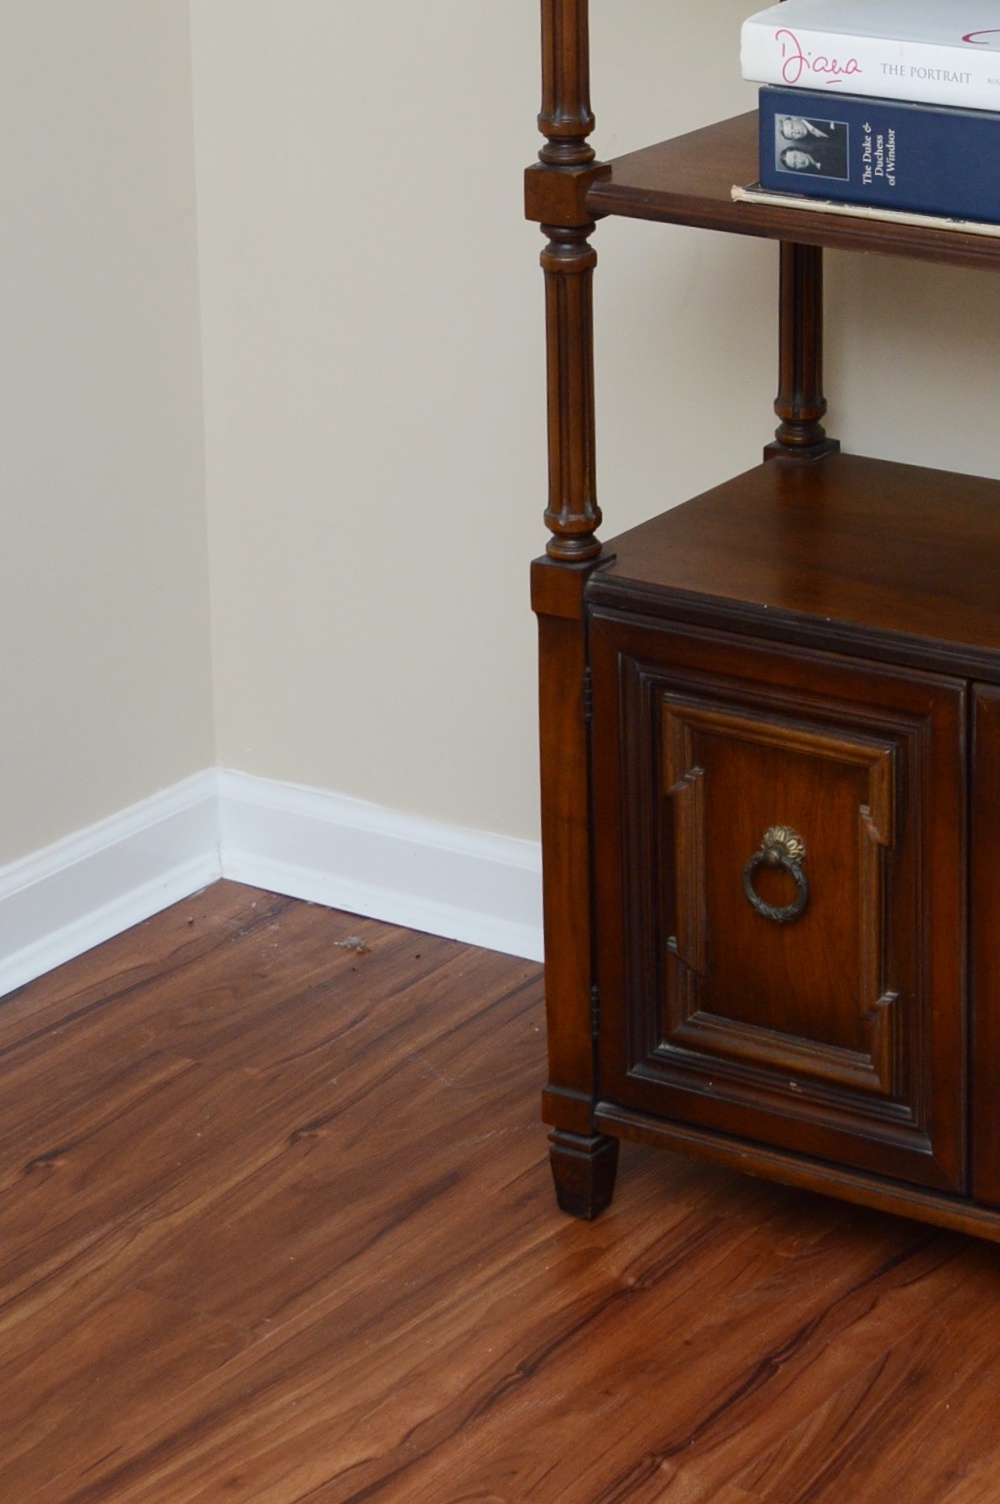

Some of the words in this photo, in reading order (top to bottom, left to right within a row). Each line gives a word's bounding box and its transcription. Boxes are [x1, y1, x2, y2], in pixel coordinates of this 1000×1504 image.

[776, 29, 862, 84] Diana
[881, 62, 906, 76] THE
[910, 67, 972, 84] PORTRAIT
[862, 122, 872, 133] &
[862, 135, 873, 164] Duke
[874, 134, 884, 177] Duchess
[886, 128, 896, 173] Windsor
[862, 166, 873, 185] The
[886, 172, 896, 186] of
